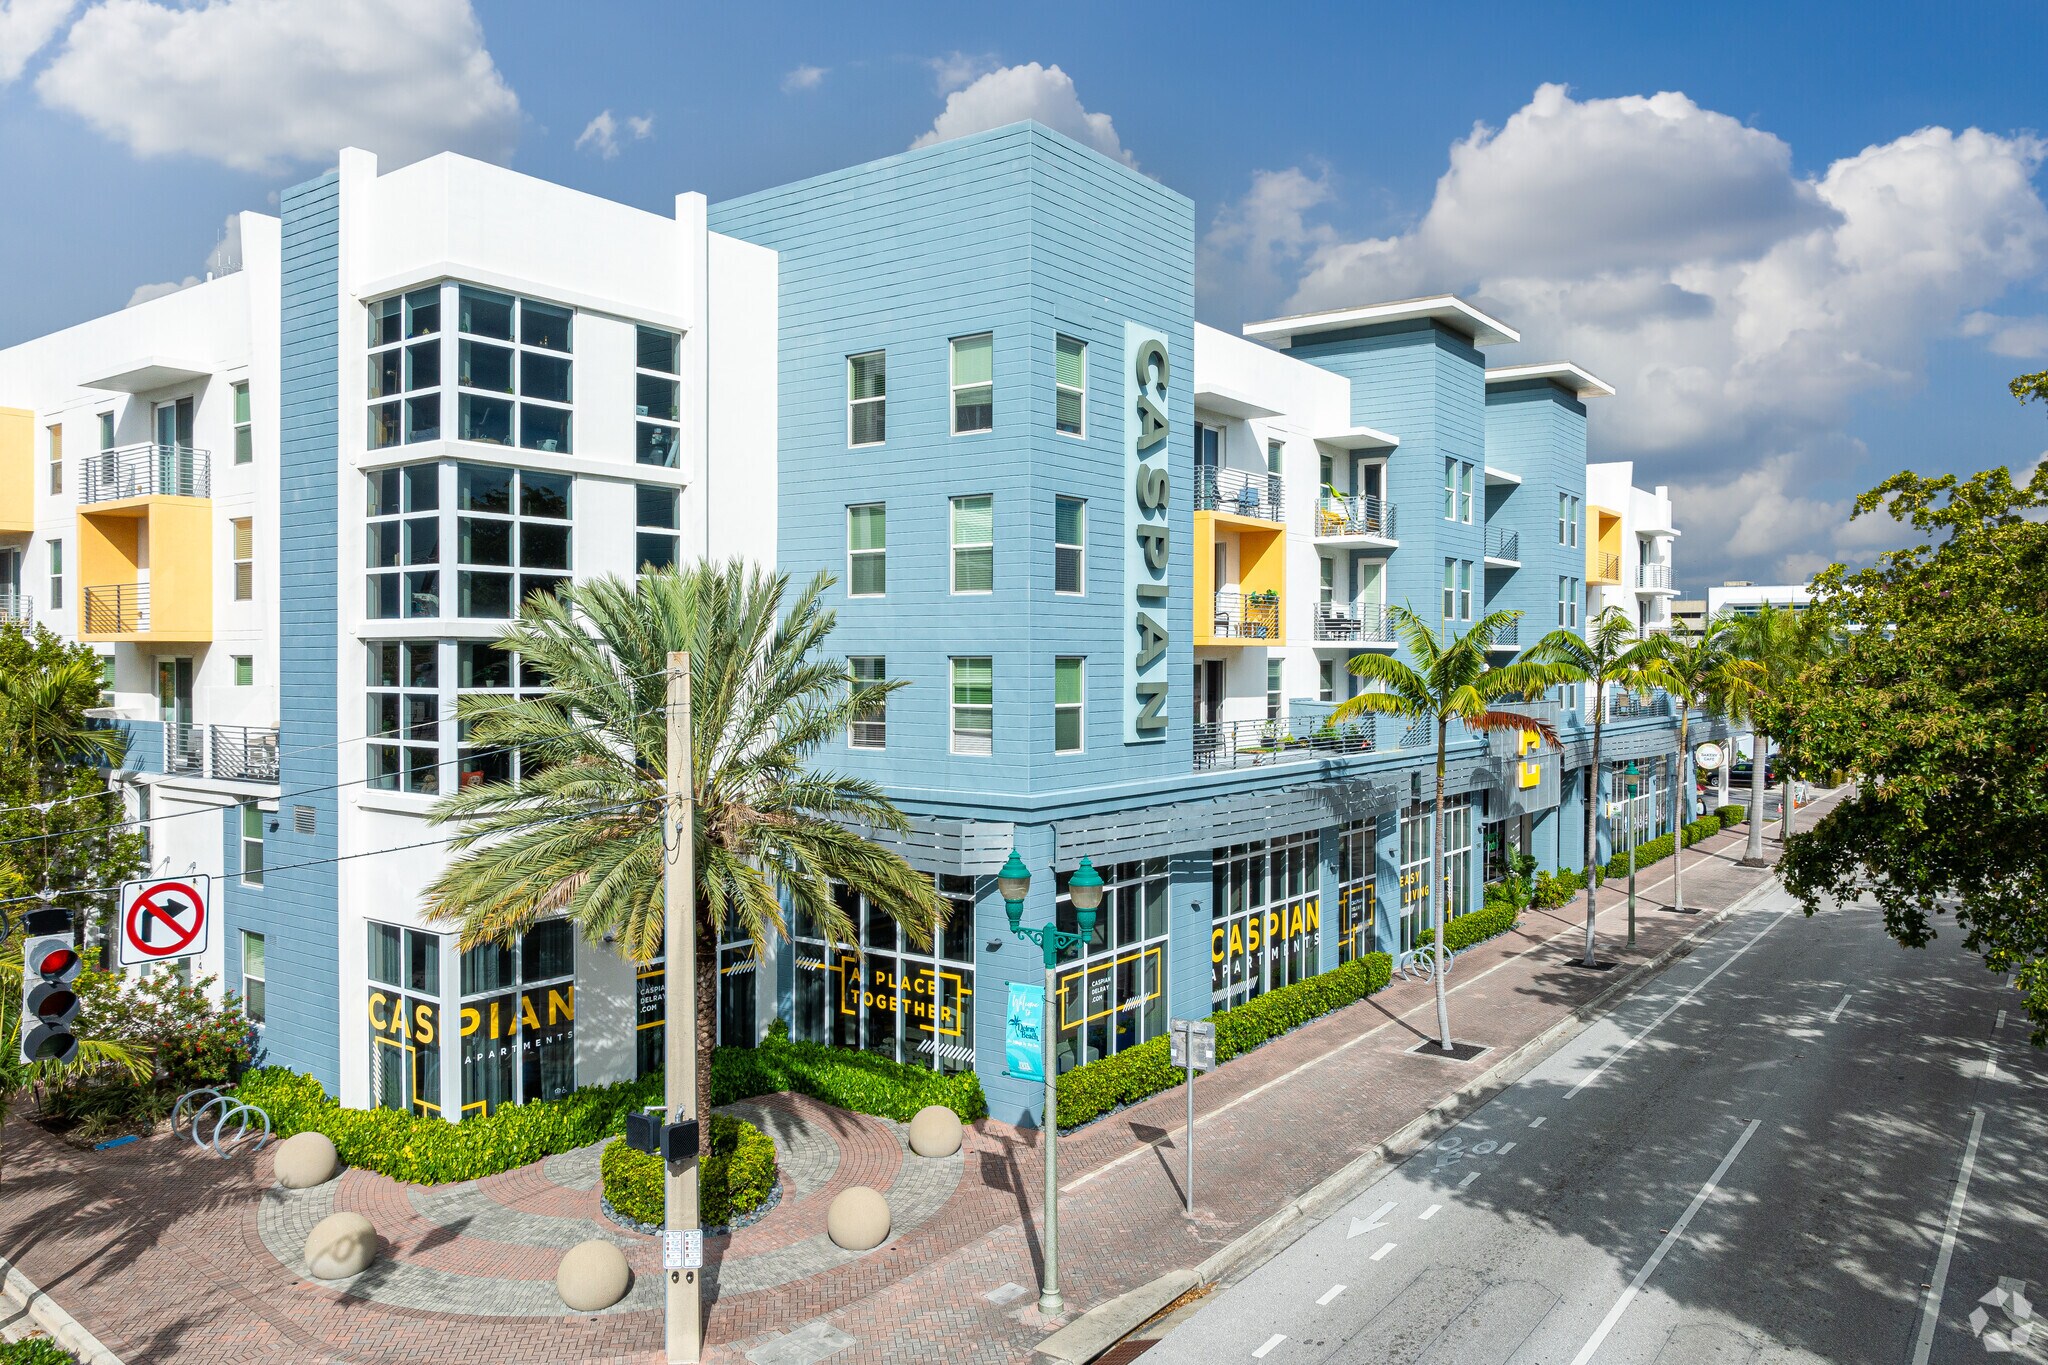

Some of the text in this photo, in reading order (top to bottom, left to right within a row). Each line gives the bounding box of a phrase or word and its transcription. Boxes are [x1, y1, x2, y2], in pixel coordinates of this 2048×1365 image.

[1136, 339, 1170, 731] CASPIAN
[1399, 871, 1420, 888] EASY
[1211, 900, 1320, 963] CASPIAN
[1211, 932, 1320, 982] APARTMENTS
[640, 984, 666, 996] CASPIA
[875, 970, 937, 996] PLACE
[1091, 976, 1112, 988] CASPIAN
[1091, 985, 1110, 996] DELRAY
[640, 1003, 657, 1013] .COM
[850, 989, 951, 1022] TOGETHER
[464, 1031, 573, 1065] APARTMENTS
